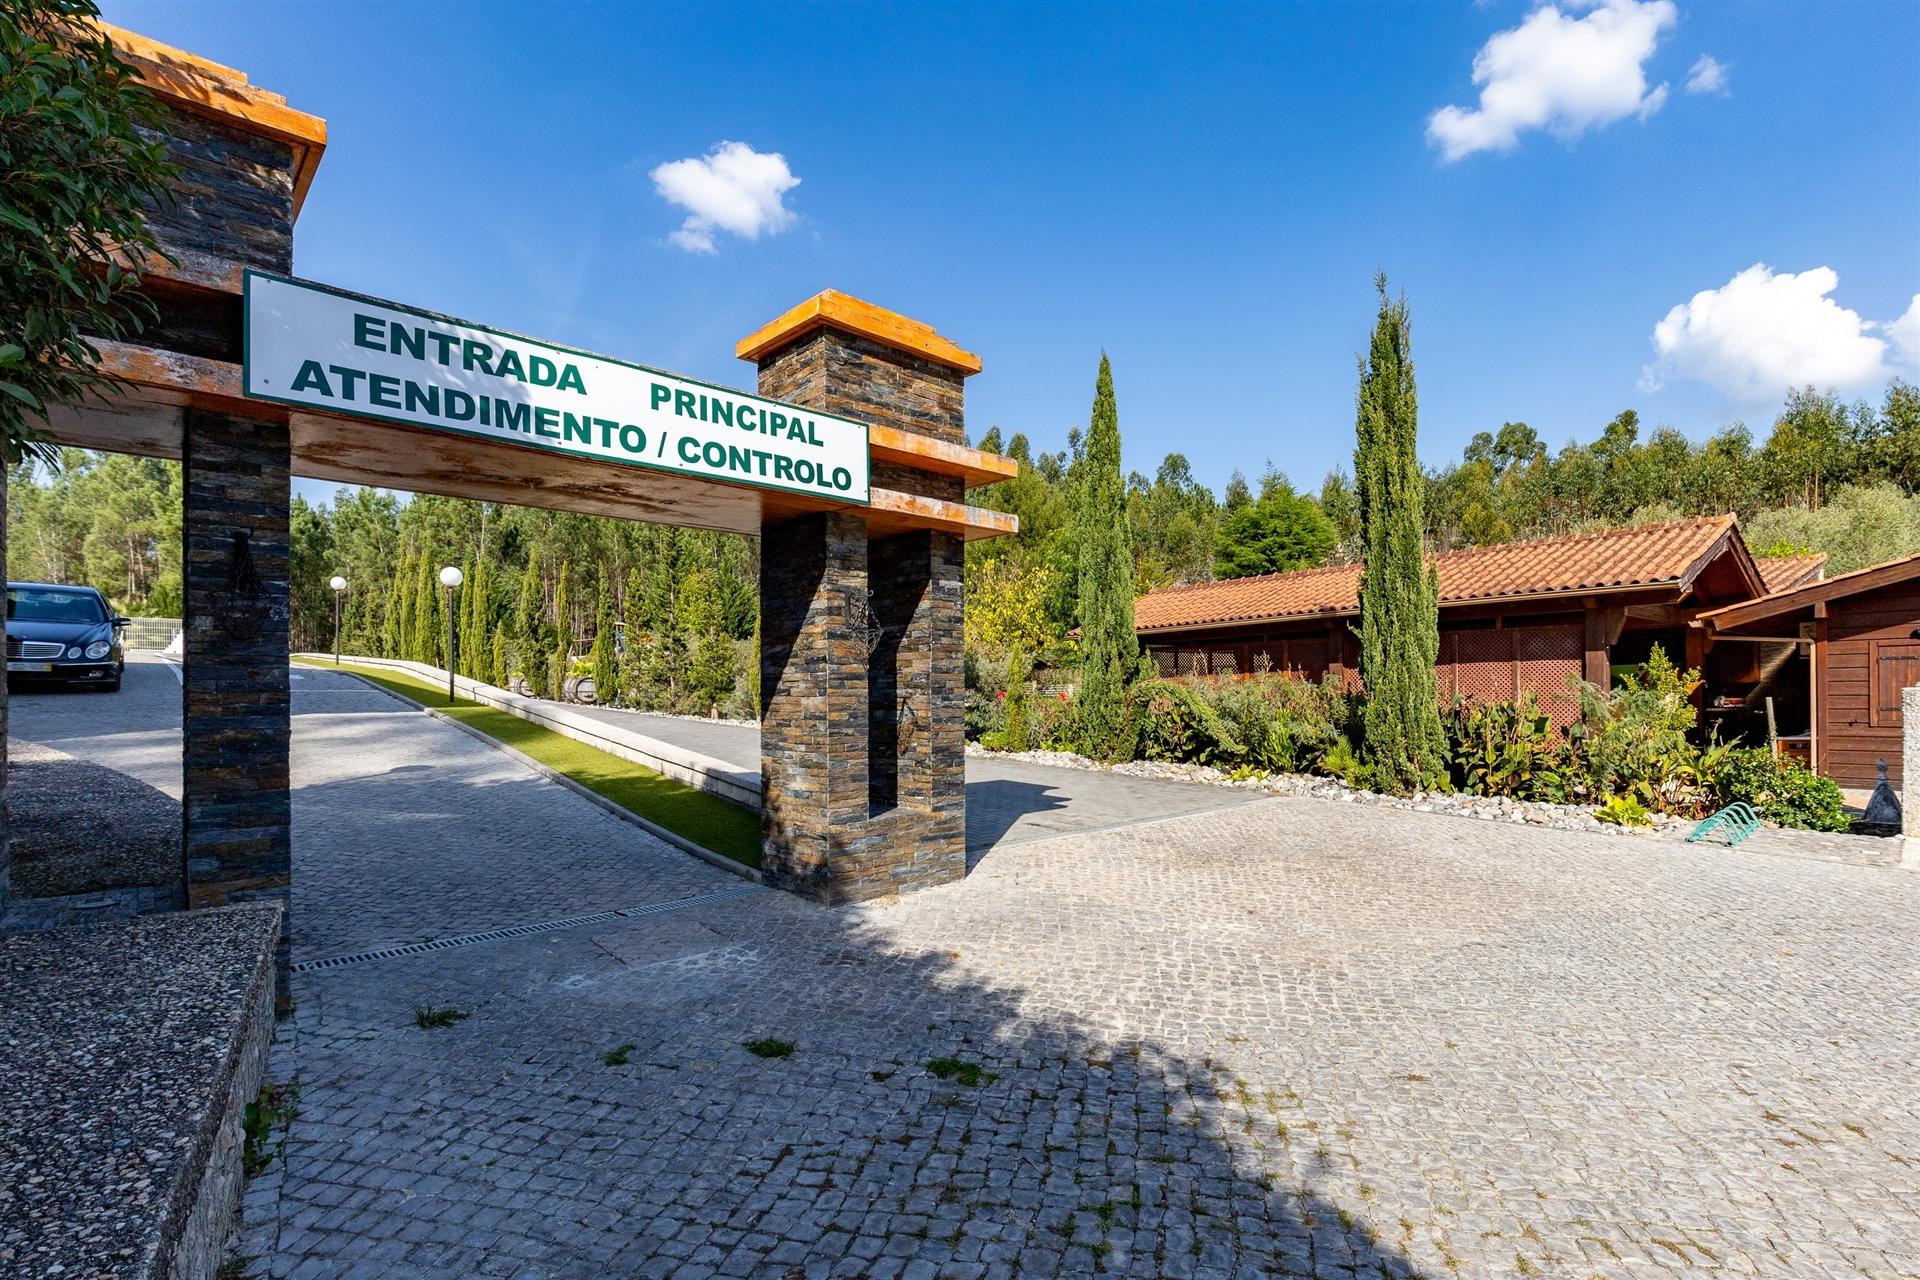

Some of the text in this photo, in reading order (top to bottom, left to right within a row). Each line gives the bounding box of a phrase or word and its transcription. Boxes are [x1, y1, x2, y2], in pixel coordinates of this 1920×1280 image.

[290, 359, 853, 492] ATENDIMENTO / CONTROLO
[353, 312, 825, 448] ENTRADA PRINCIPAL
